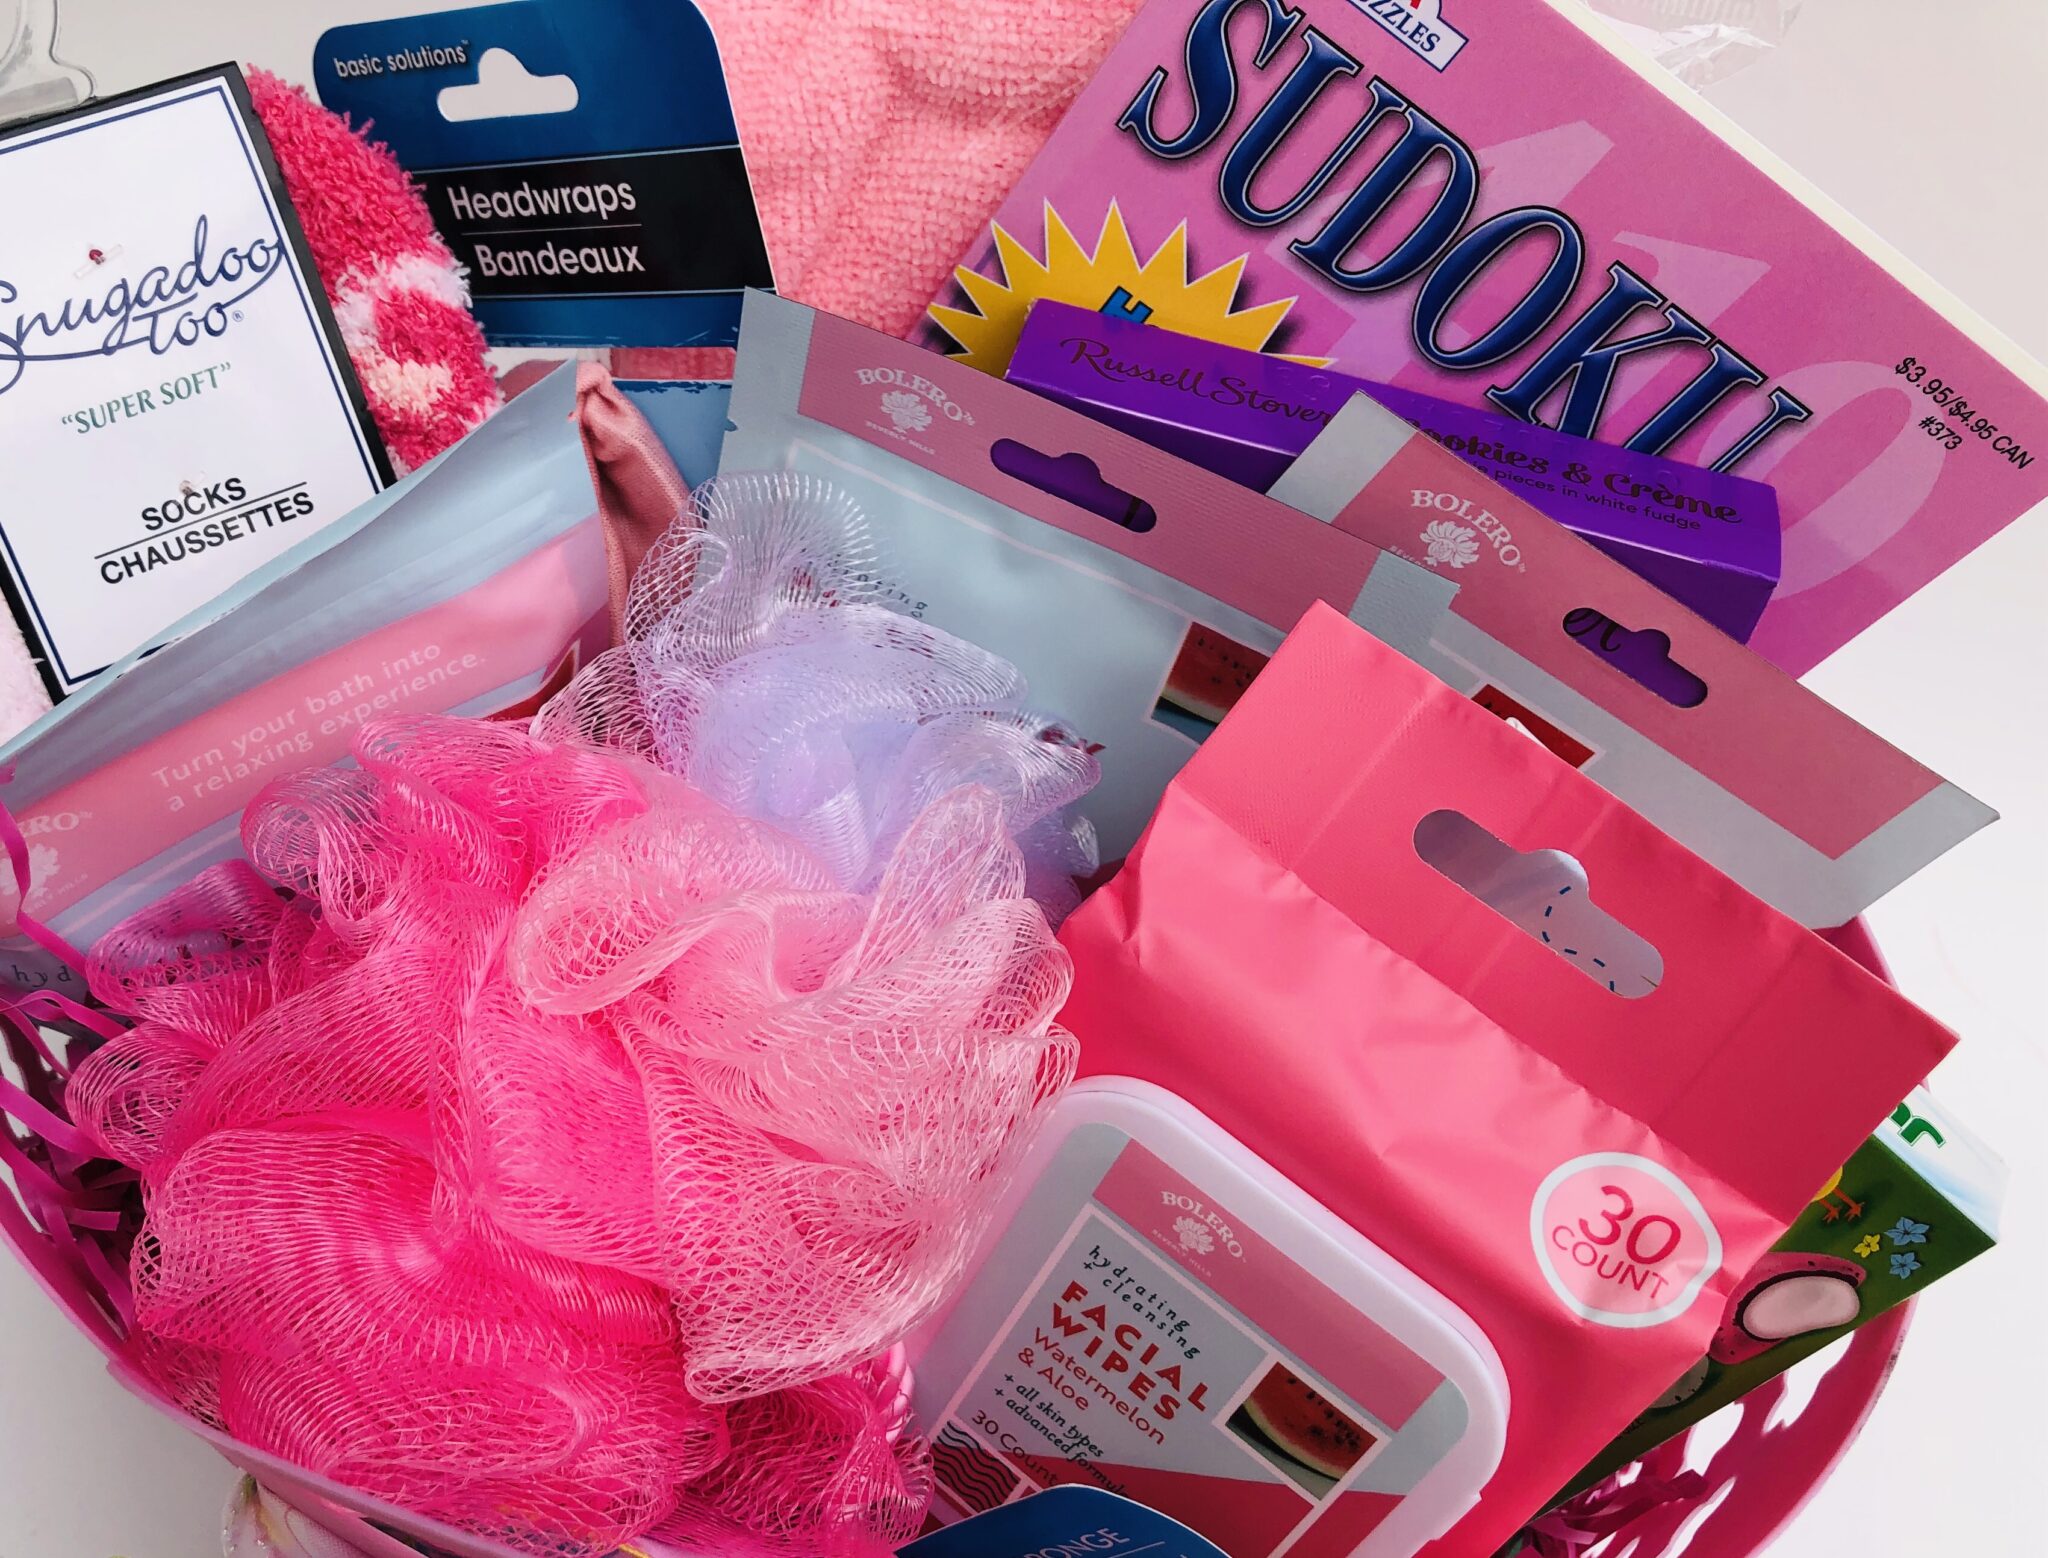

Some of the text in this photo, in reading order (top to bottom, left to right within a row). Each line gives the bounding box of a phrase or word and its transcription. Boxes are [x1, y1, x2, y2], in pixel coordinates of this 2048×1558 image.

[1360, 0, 1441, 52] ZZLES
[333, 53, 384, 78] basic
[447, 180, 637, 221] Headwraps
[1115, 0, 1813, 476] SUDOKU
[474, 241, 646, 278] Bandeaux
[1060, 337, 1333, 426] Russell Stover
[1895, 356, 2035, 470] $3.95/$4.95 CAN
[1918, 415, 1963, 450] #373
[142, 477, 247, 532] SOCKS
[1405, 418, 1744, 525] ookies & Crème
[1494, 467, 1702, 531] pieces in white fudge
[100, 491, 315, 585] CHAUSSETTES
[152, 644, 441, 788] Turn your bath into
[168, 651, 486, 812] a relaxing experience.
[1160, 1190, 1243, 1258] BOLERO
[1552, 1225, 1669, 1299] COUNT
[1579, 1185, 1682, 1265] 30
[1089, 1245, 1190, 1332] hydrating
[1103, 1277, 1200, 1360] cleansing
[1018, 1347, 1090, 1411] & Aloe
[1053, 1303, 1181, 1420] WIPES
[1061, 1280, 1208, 1412] FACIAL
[1016, 1383, 1040, 1402] all
[1036, 1401, 1066, 1427] skin
[1062, 1425, 1104, 1458] types
[1034, 1327, 1165, 1445] Watermelon
[971, 1410, 1058, 1486] 30 Count
[1006, 1398, 1080, 1454] advanced
[1023, 1527, 1131, 1558] ONGE
